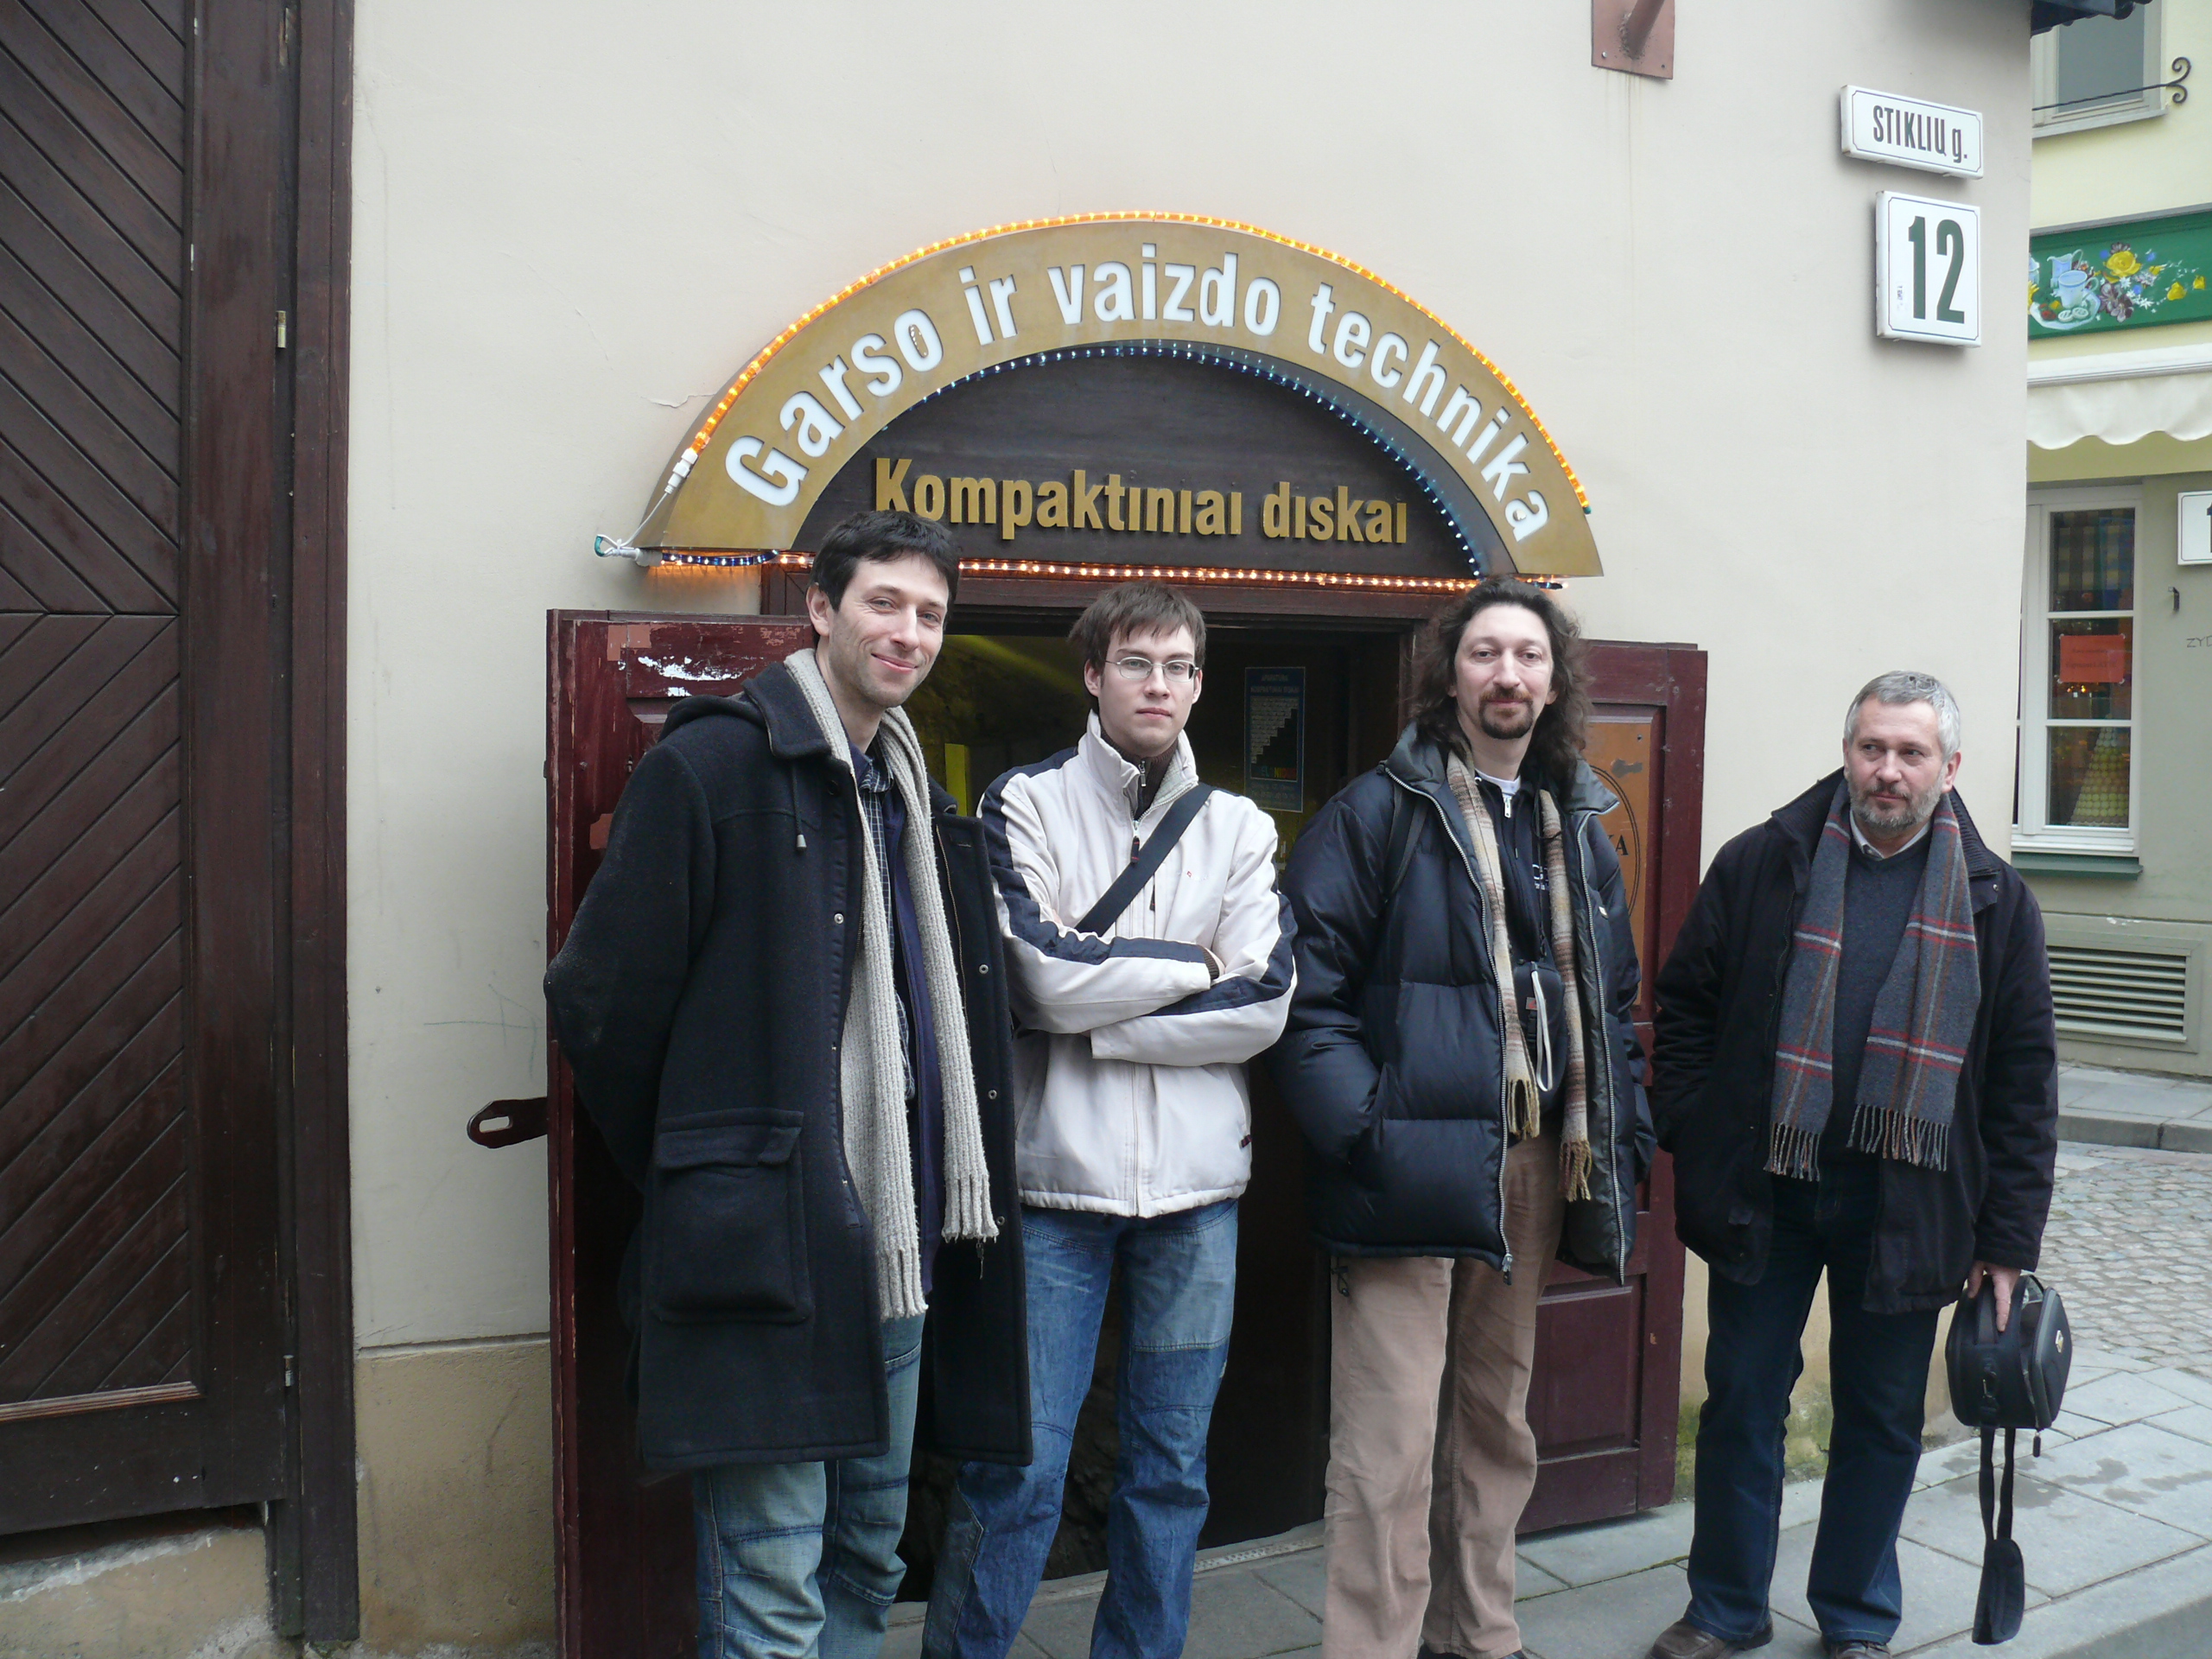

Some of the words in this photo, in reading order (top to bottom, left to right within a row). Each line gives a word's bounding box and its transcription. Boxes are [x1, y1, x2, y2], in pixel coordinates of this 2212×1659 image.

[1951, 126, 1968, 163] g.
[1908, 215, 1966, 325] 12
[724, 307, 944, 507] Garso
[959, 264, 1018, 346] ir
[1046, 242, 1281, 338] vaizdo
[1307, 283, 1549, 543] technika
